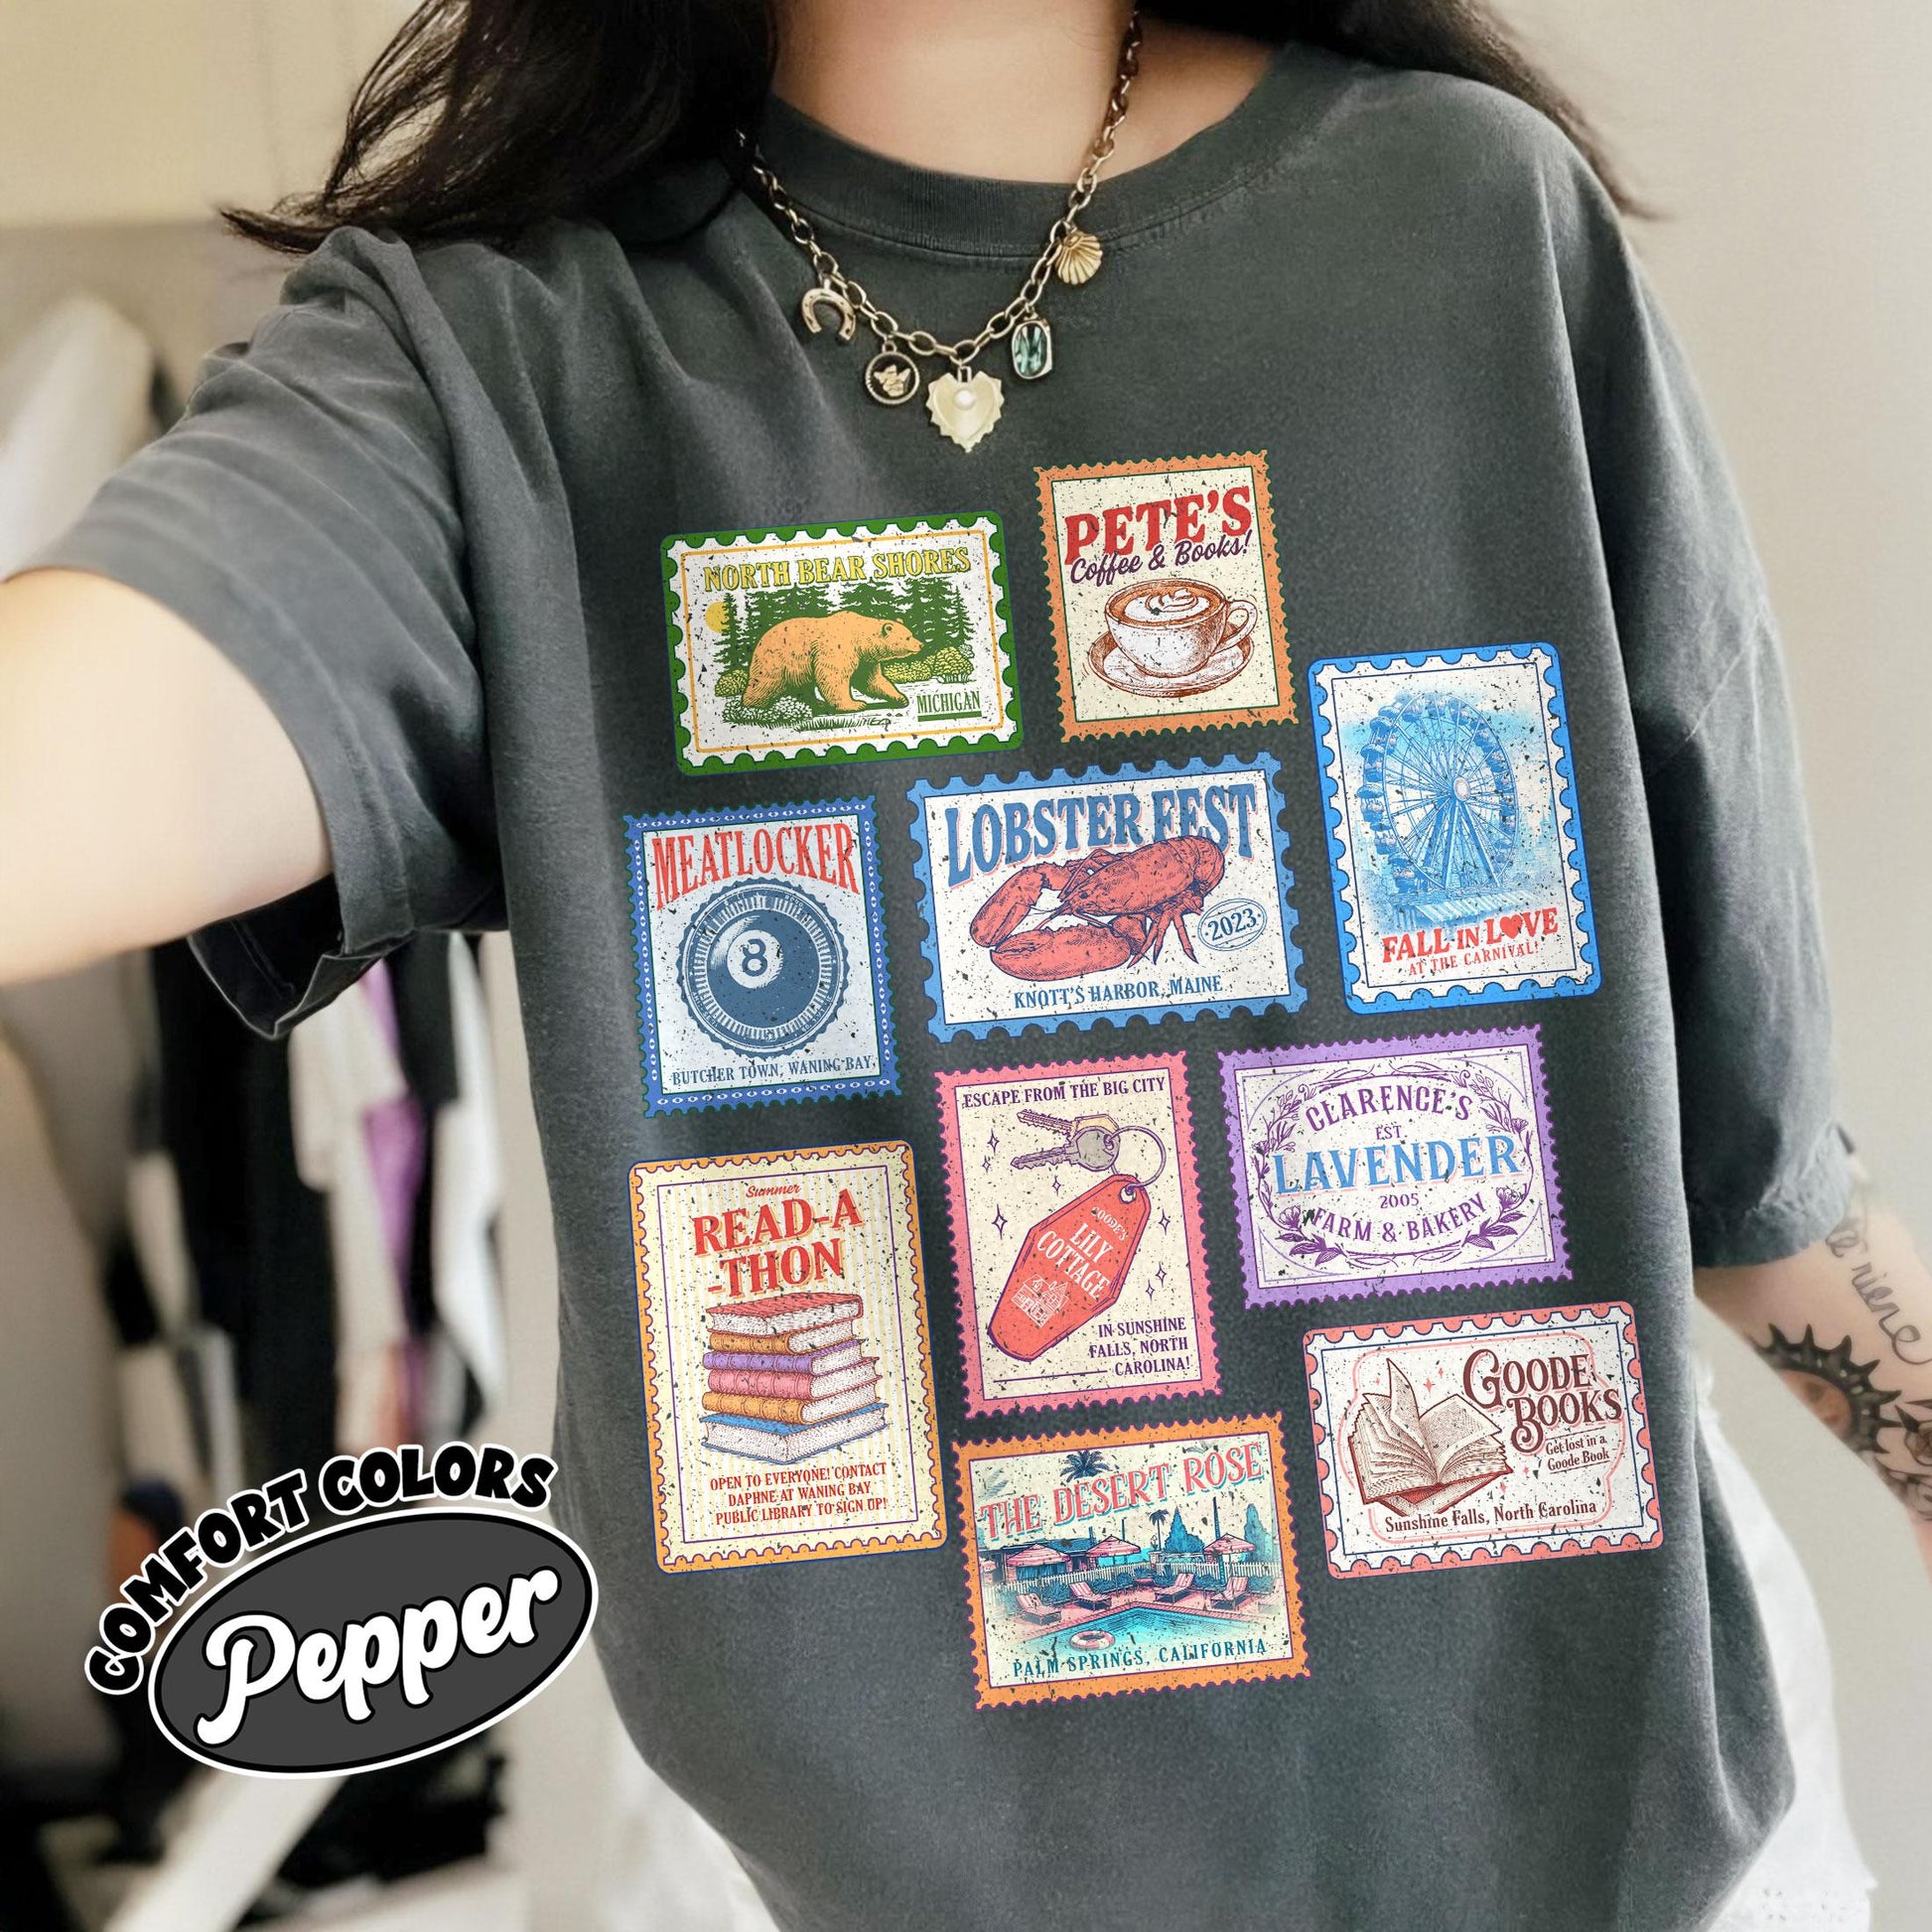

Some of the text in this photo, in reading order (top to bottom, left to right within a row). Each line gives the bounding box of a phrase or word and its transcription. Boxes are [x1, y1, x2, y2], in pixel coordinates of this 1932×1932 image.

[1064, 485, 1252, 565] PETE'S
[703, 547, 971, 592] NORTH BEAR SHORES
[1070, 530, 1253, 587] Coffee & Books!
[916, 691, 981, 715] MICHIGAN
[945, 783, 1257, 890] LOBSTER FEST
[651, 823, 860, 910] MEATLOCKER
[1208, 907, 1257, 941] 2023
[742, 938, 767, 977] 8
[1382, 928, 1450, 963] FALL
[1456, 927, 1479, 950] IN
[1409, 941, 1540, 976] AT THE CARNIVAL!
[1014, 976, 1222, 1009] KNOTT'S HARBOR, MAINE
[672, 1067, 735, 1085] BUTCHER
[788, 1058, 841, 1074] WANING
[846, 1055, 872, 1070] BAY
[964, 1077, 1165, 1108] ESCAPE FROM THE BIG CITY
[1306, 1085, 1473, 1131] CLARENCE'S
[1376, 1125, 1402, 1140] EST
[1272, 1135, 1524, 1196] LAVENDER
[746, 1183, 801, 1199] Summer
[1380, 1193, 1419, 1209] 2005
[1311, 1192, 1487, 1242] FARM & BAKERY
[1069, 1223, 1113, 1263] LILY
[1036, 1231, 1110, 1302] COTTAGE
[1098, 1317, 1186, 1338] IN SUNSHINE
[1089, 1336, 1188, 1358] FALLS, NORTH
[1115, 1357, 1190, 1376] CAROLINA!
[1506, 1388, 1623, 1454] BOOKS
[1546, 1442, 1563, 1454] Get
[1566, 1438, 1585, 1451] lost
[1587, 1437, 1596, 1447] in
[1548, 1448, 1609, 1470] Goode Book
[710, 1462, 887, 1491] OPEN TO EVERYONE! CONTACT
[729, 1481, 872, 1506] DAPHNE AT WANING BAY
[980, 1443, 1264, 1541] THE DESERT ROSE
[716, 1497, 887, 1525] PUBLIC LIBRARY TO SIGN UP!
[1385, 1501, 1596, 1533] Sunshine Falls, North Carolina
[1014, 1639, 1267, 1678] PALM SPRINGS, CALIFORNIA
